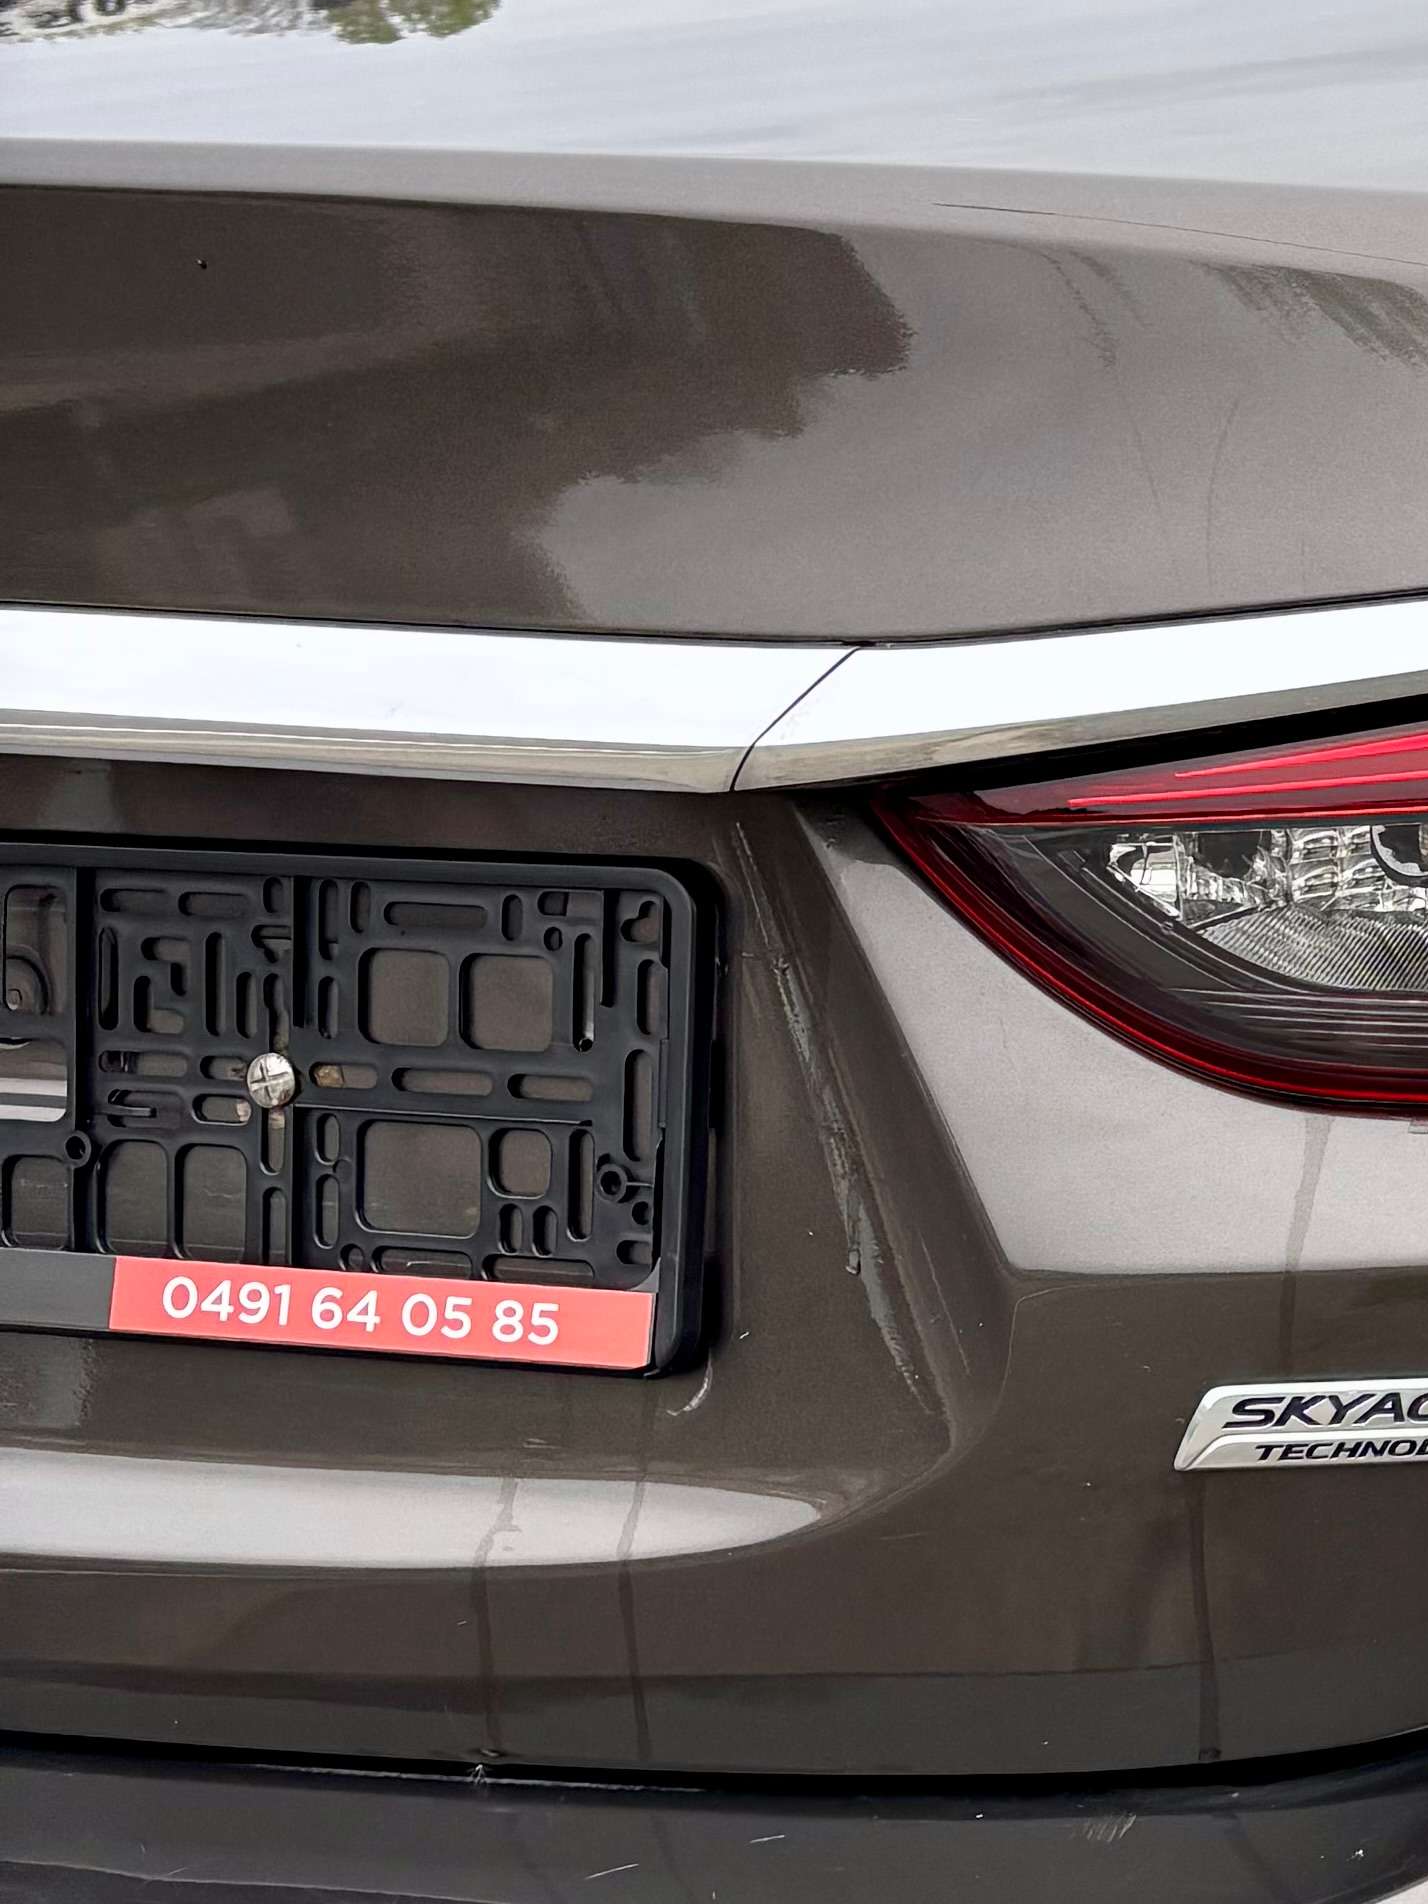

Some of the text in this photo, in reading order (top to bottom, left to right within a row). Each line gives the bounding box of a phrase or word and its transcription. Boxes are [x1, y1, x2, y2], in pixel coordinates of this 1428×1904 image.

[162, 1275, 560, 1345] 0491 64 05 85
